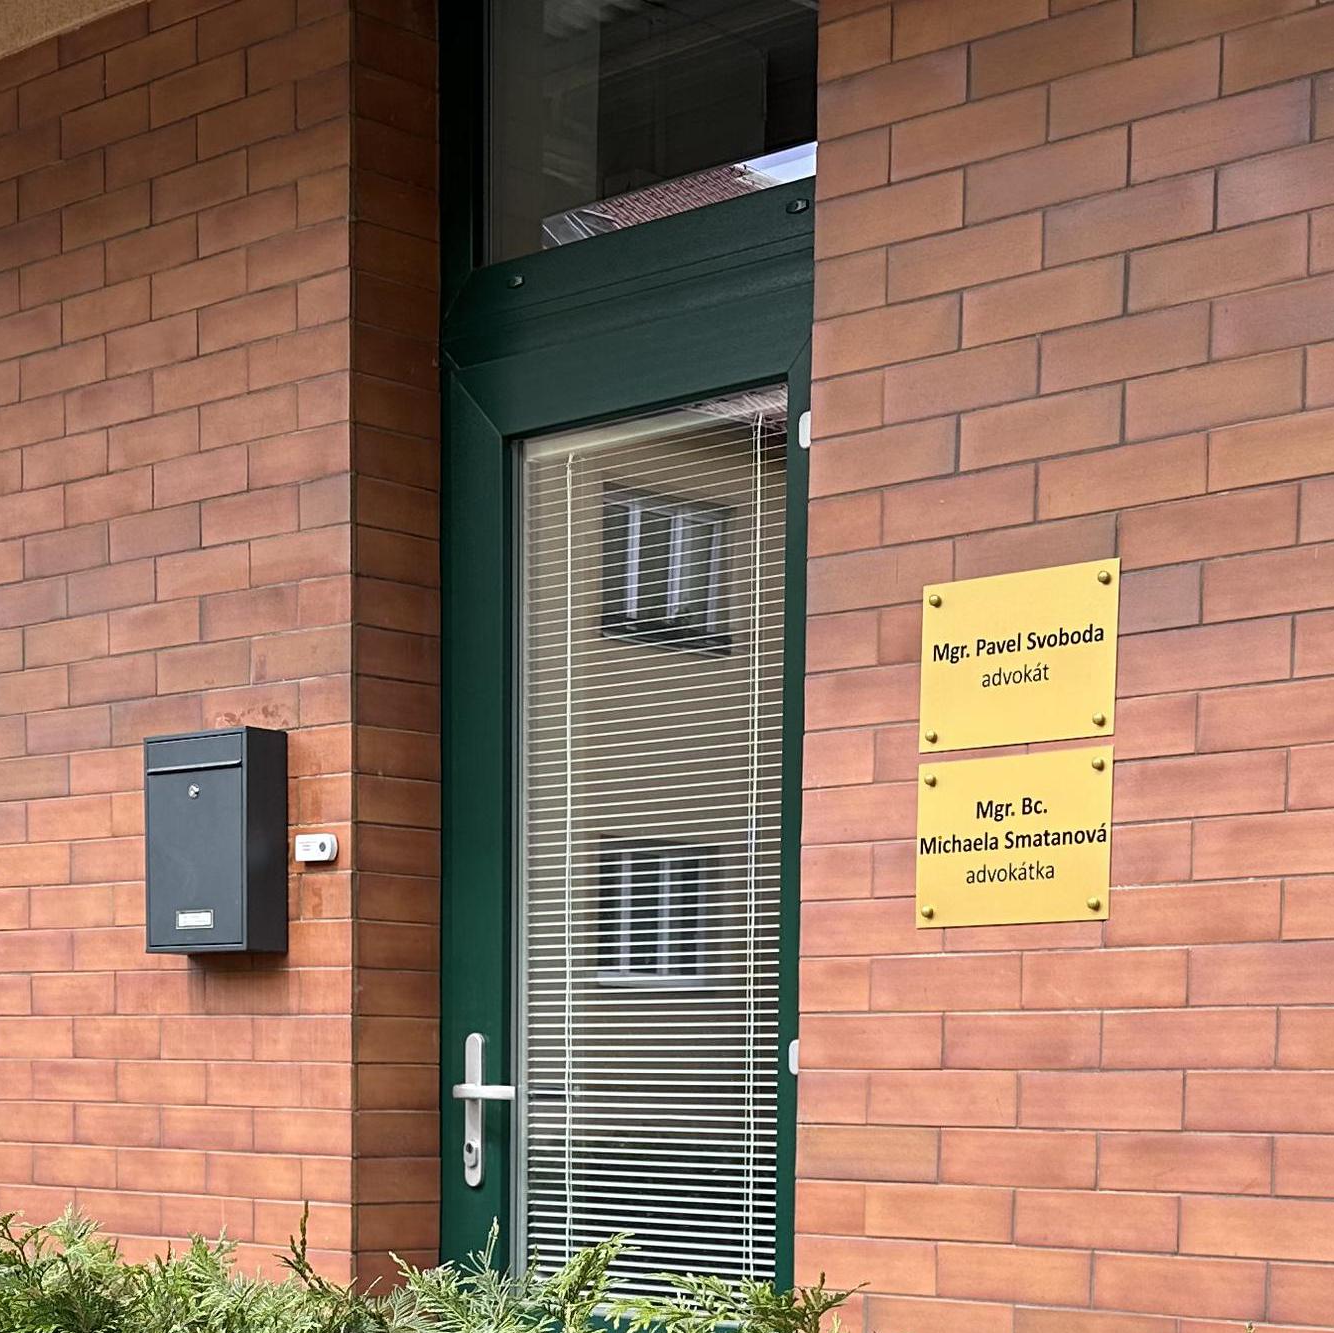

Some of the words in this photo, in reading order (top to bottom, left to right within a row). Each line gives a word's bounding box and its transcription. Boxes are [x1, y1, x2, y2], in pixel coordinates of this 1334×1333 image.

[933, 643, 970, 664] Mgr.
[976, 633, 1021, 656] Pavel
[1026, 623, 1104, 650] Svoboda
[981, 662, 1049, 687] advokát
[976, 799, 1015, 822] Mgr.
[1021, 797, 1047, 815] Bc.
[919, 831, 998, 855] Michaela
[1003, 823, 1106, 849] Smatanová
[966, 860, 1054, 884] advokátka
